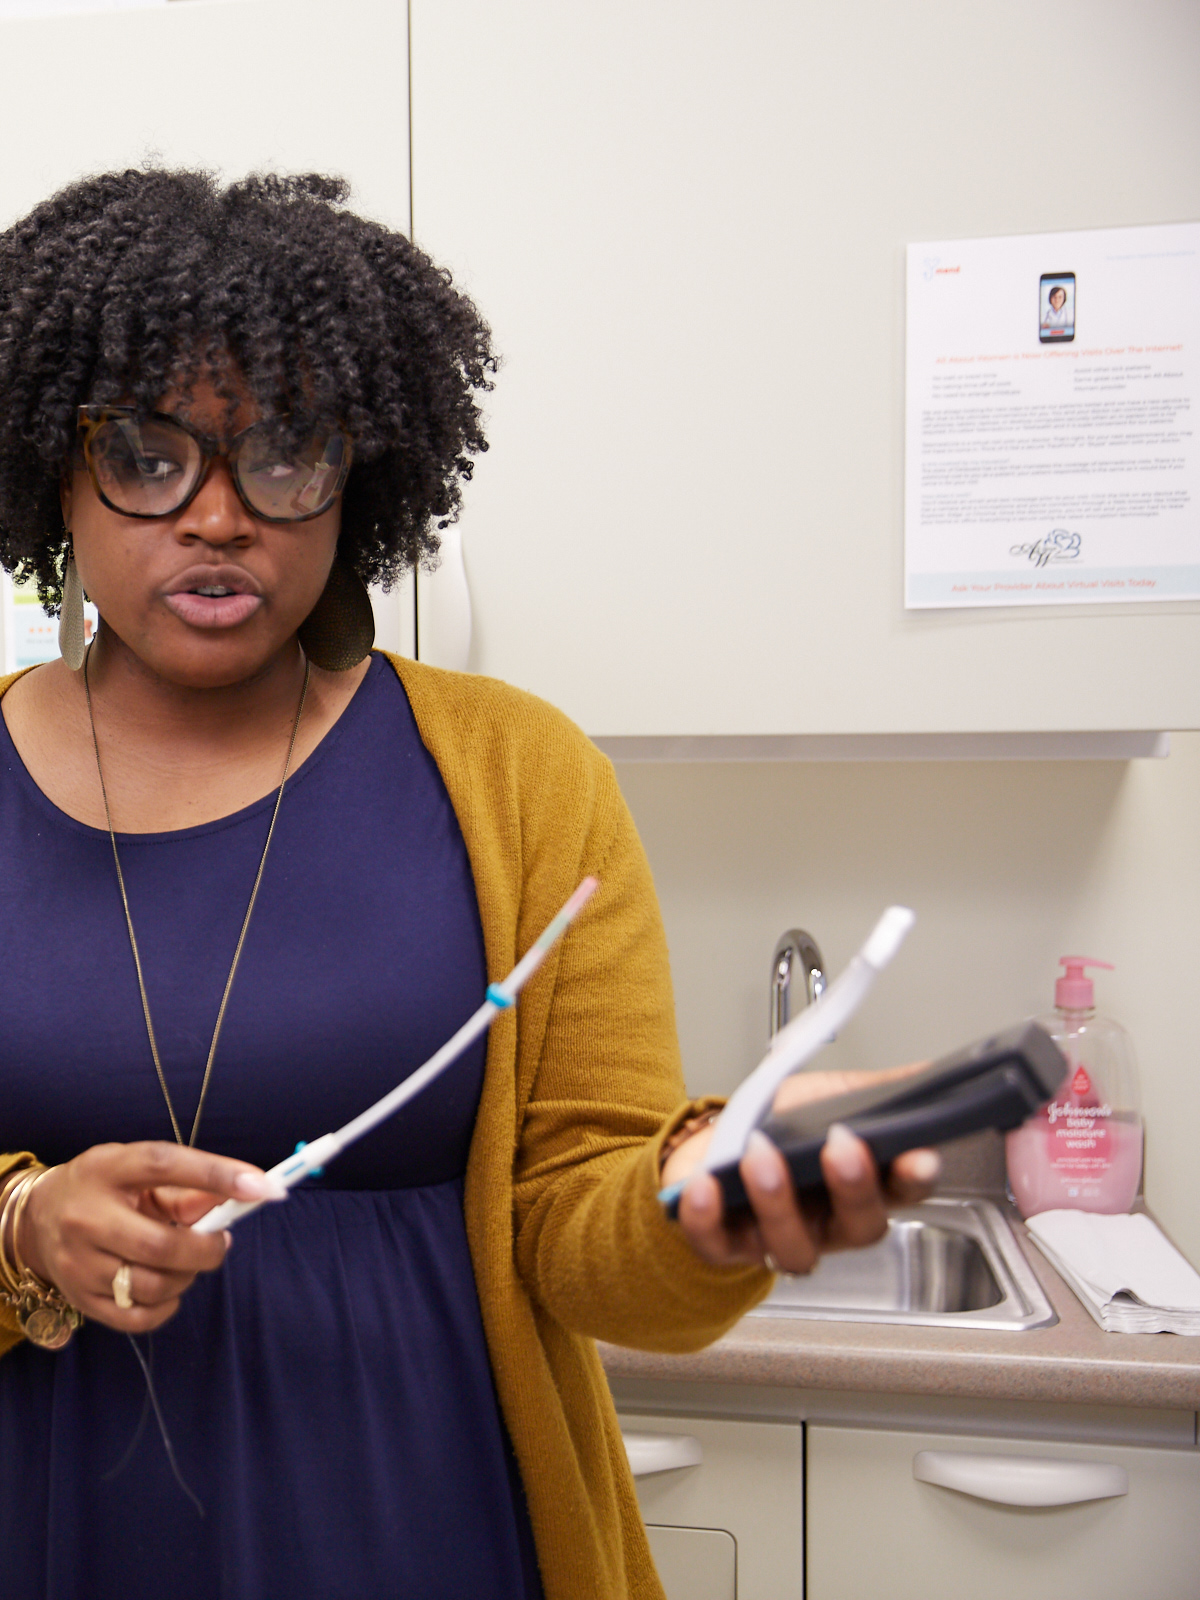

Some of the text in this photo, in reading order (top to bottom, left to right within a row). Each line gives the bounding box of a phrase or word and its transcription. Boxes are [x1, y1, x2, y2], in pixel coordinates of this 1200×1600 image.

[948, 354, 974, 363] About
[1104, 346, 1126, 356] Over
[951, 577, 1157, 592] Ask Your Provider About Virtual Visits Today
[1066, 1118, 1096, 1129] baby
[1055, 1128, 1107, 1139] moisture
[1065, 1139, 1097, 1149] wash
